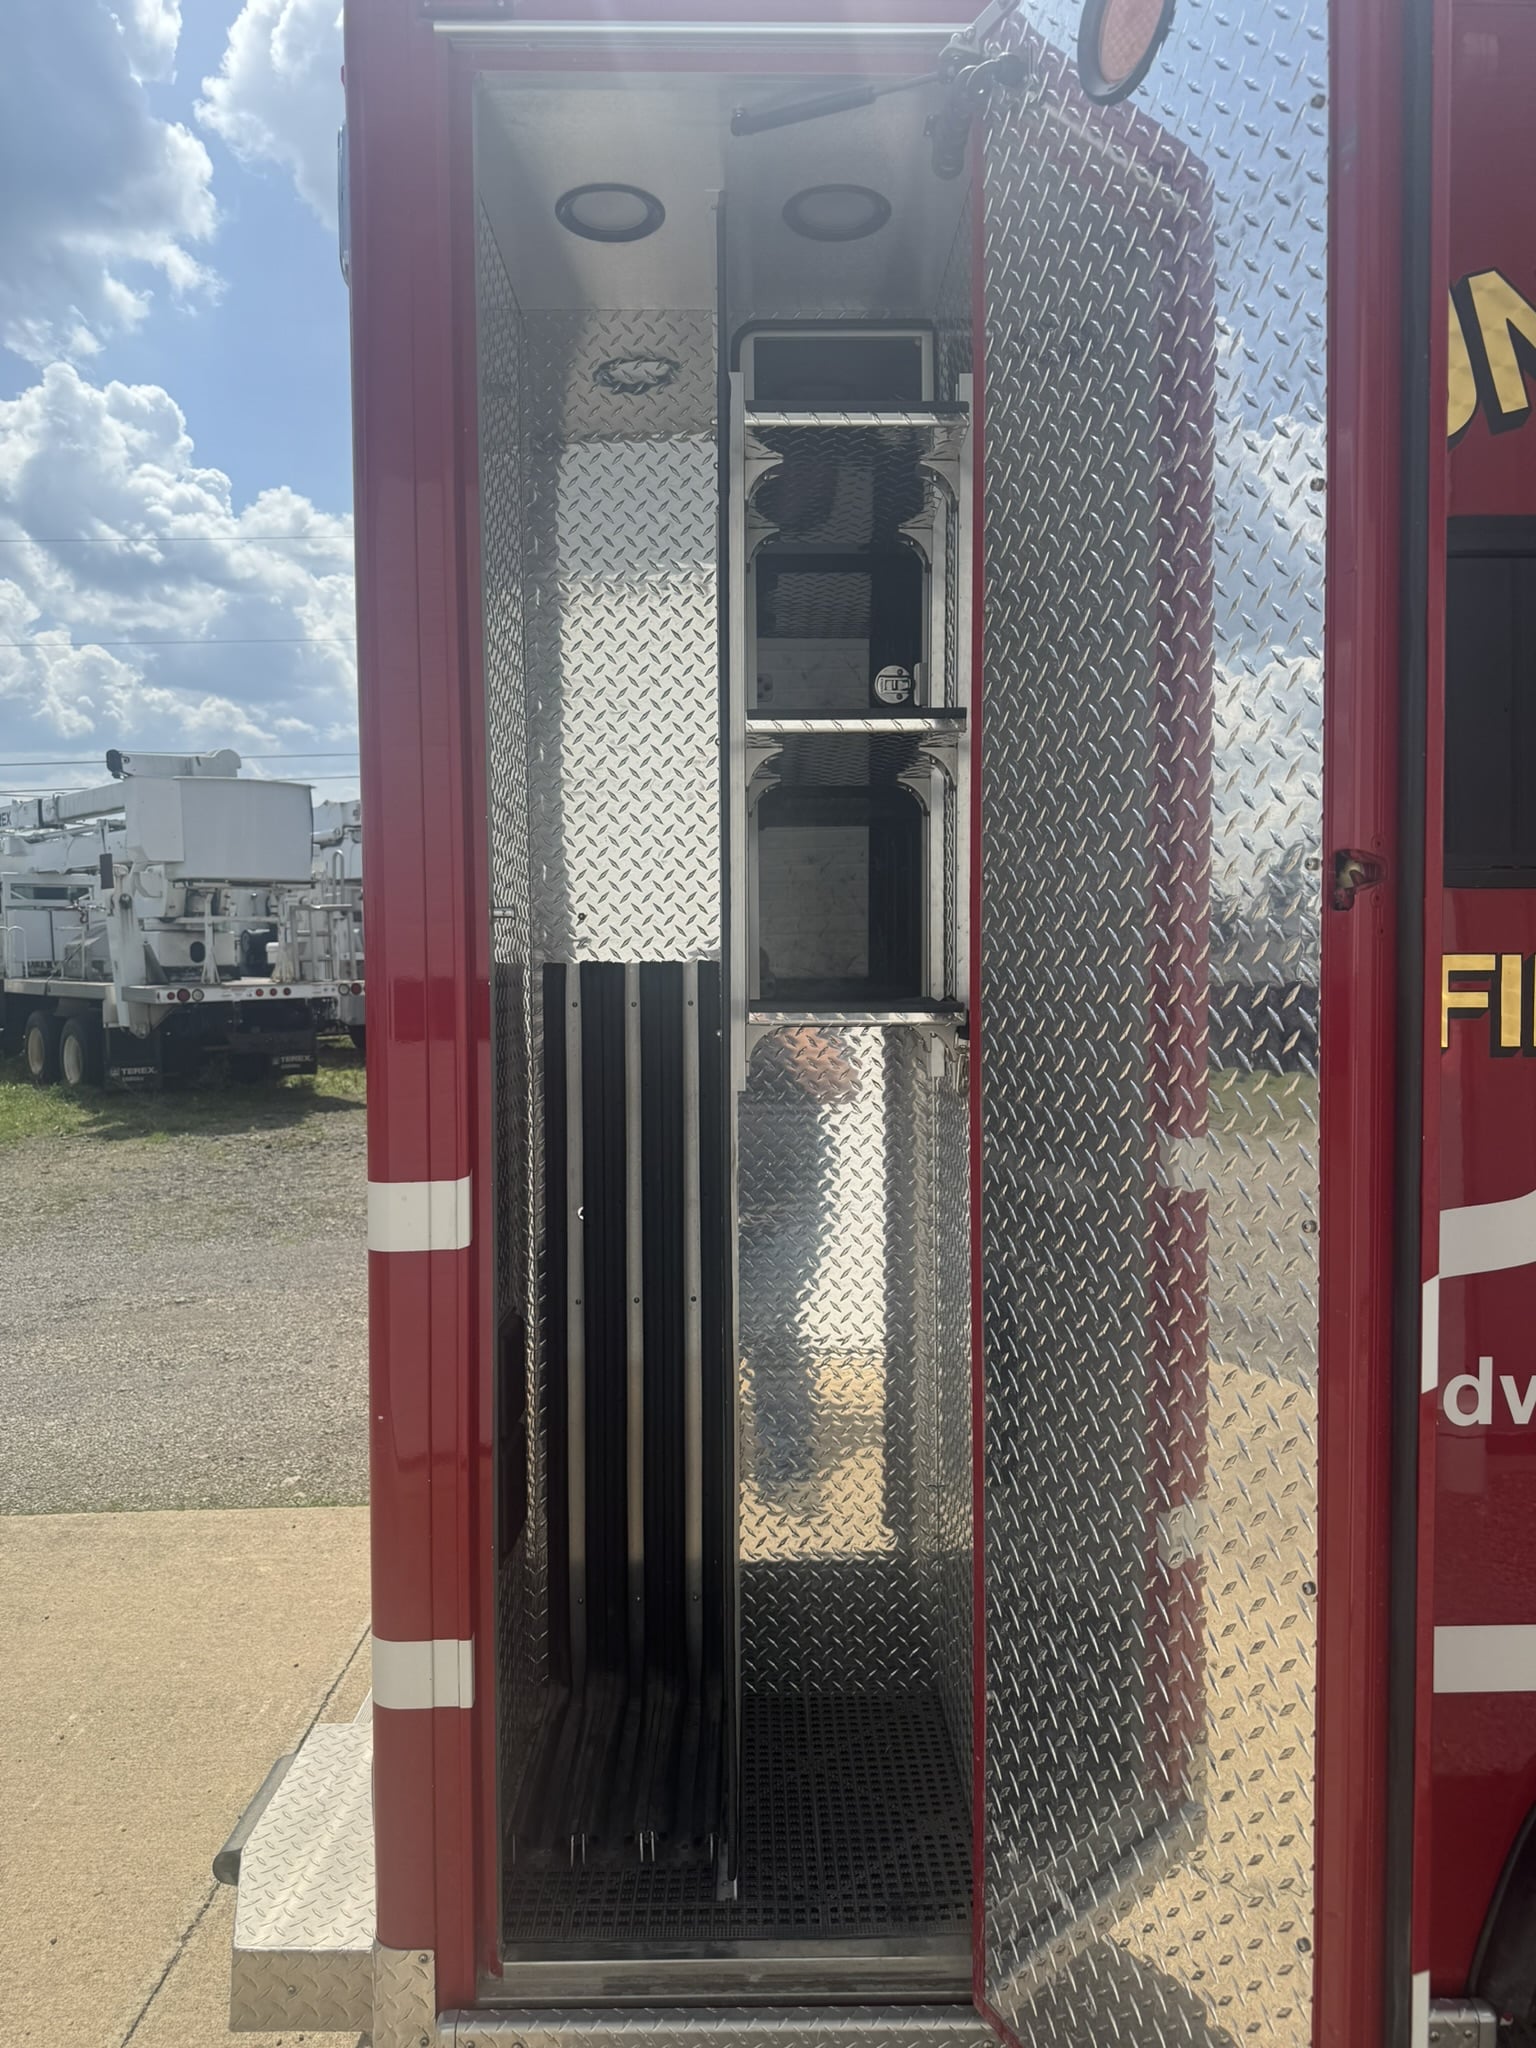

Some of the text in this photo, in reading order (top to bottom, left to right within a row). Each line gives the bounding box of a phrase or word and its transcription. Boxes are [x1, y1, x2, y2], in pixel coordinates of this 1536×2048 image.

[0, 811, 12, 827] EX
[1440, 953, 1536, 1050] FI
[121, 1066, 156, 1076] TEREX
